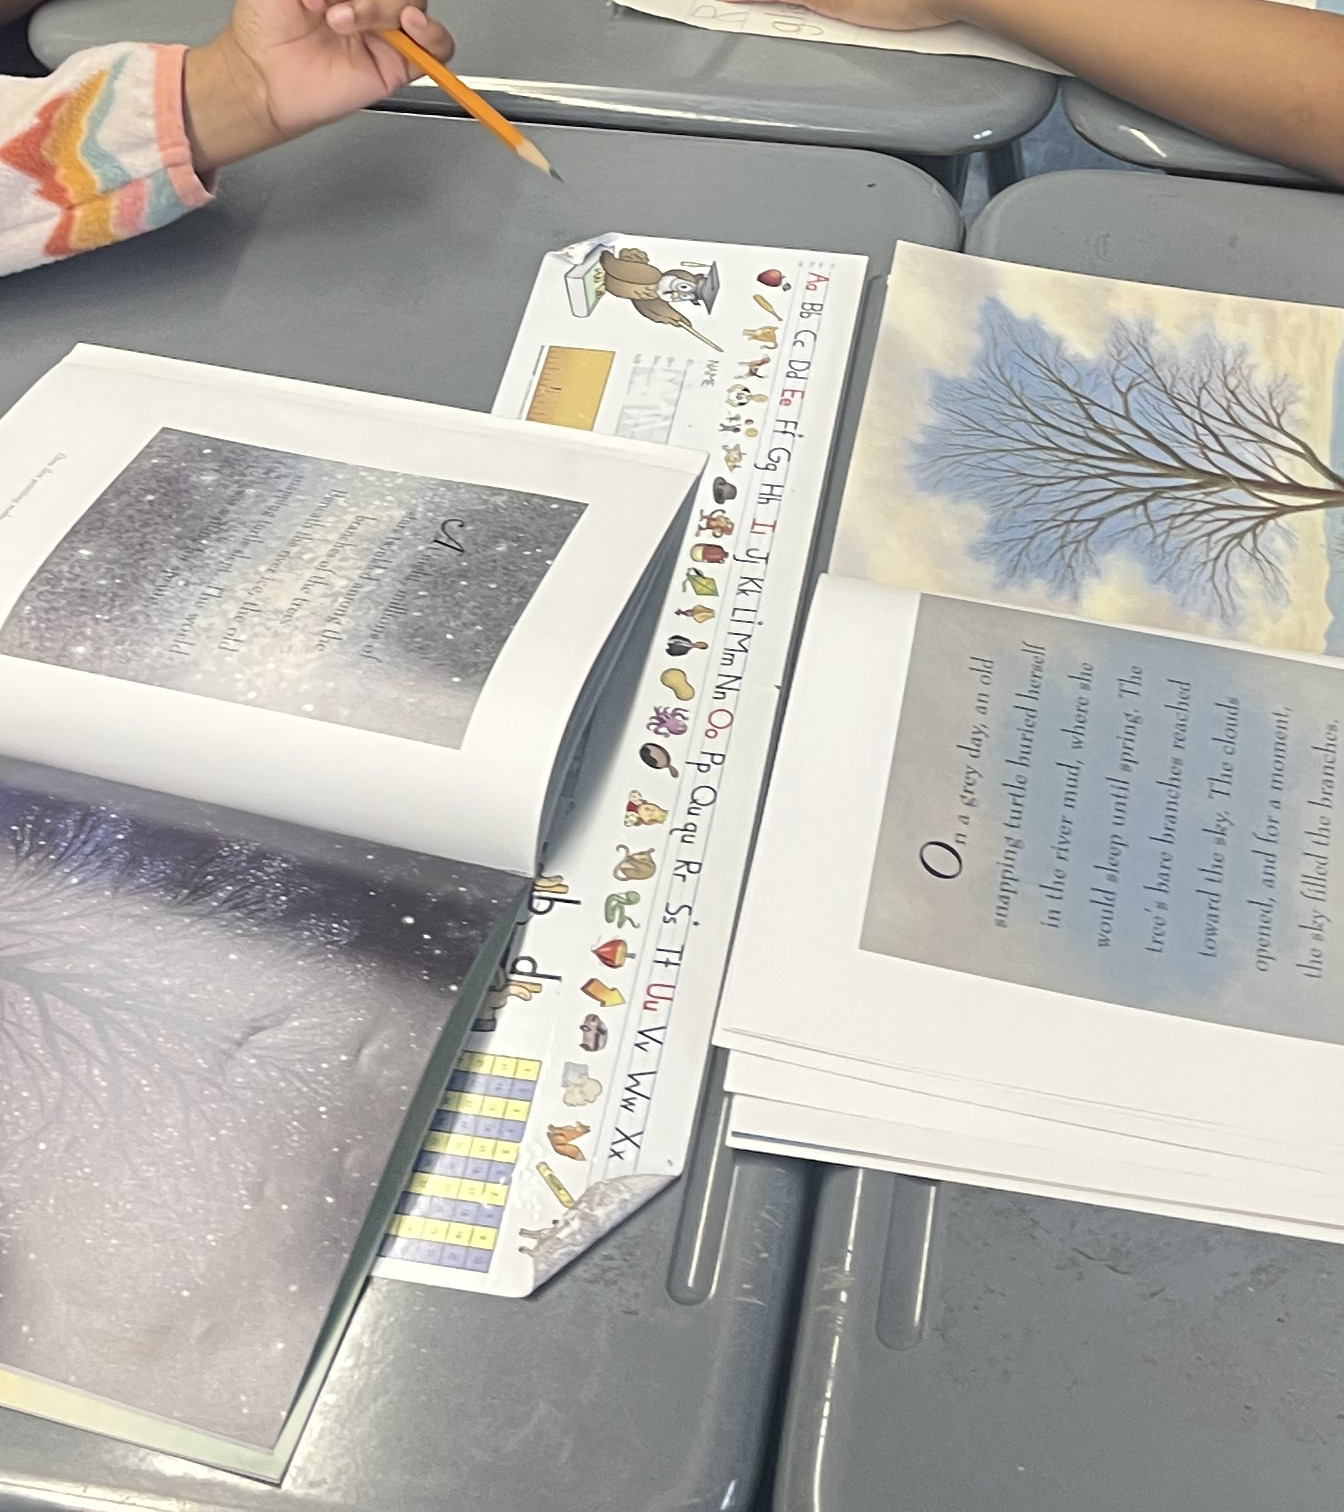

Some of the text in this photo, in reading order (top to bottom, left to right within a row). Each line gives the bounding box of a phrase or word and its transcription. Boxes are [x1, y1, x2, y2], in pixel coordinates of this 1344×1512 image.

[286, 530, 315, 548] the
[326, 514, 377, 561] branches
[265, 549, 293, 574] river
[314, 559, 338, 575] of
[299, 574, 331, 595] the
[323, 581, 365, 625] among
[232, 600, 264, 624] the
[166, 613, 209, 655] world
[216, 626, 247, 652] old
[312, 628, 344, 652] the
[357, 643, 385, 663] of
[1117, 665, 1143, 698] The
[1164, 678, 1191, 750] reached
[1211, 697, 1240, 756] clouds
[919, 656, 994, 880] On a grey day, an old
[994, 641, 1046, 928] snapping turtle buried herself
[1207, 762, 1233, 800] The
[1038, 662, 1093, 928] in the river mud, where she
[1104, 776, 1130, 826] until
[1148, 756, 1184, 845] branches
[1246, 706, 1294, 972] opened, and for a moment,
[1304, 815, 1331, 846] the
[1093, 833, 1129, 883] sleep
[1143, 852, 1172, 894] bare
[1197, 852, 1225, 884] the
[1299, 852, 1328, 902] filled
[1089, 887, 1116, 948] would
[1195, 889, 1221, 958] toward
[1297, 909, 1332, 942] sky
[1295, 948, 1323, 979] the
